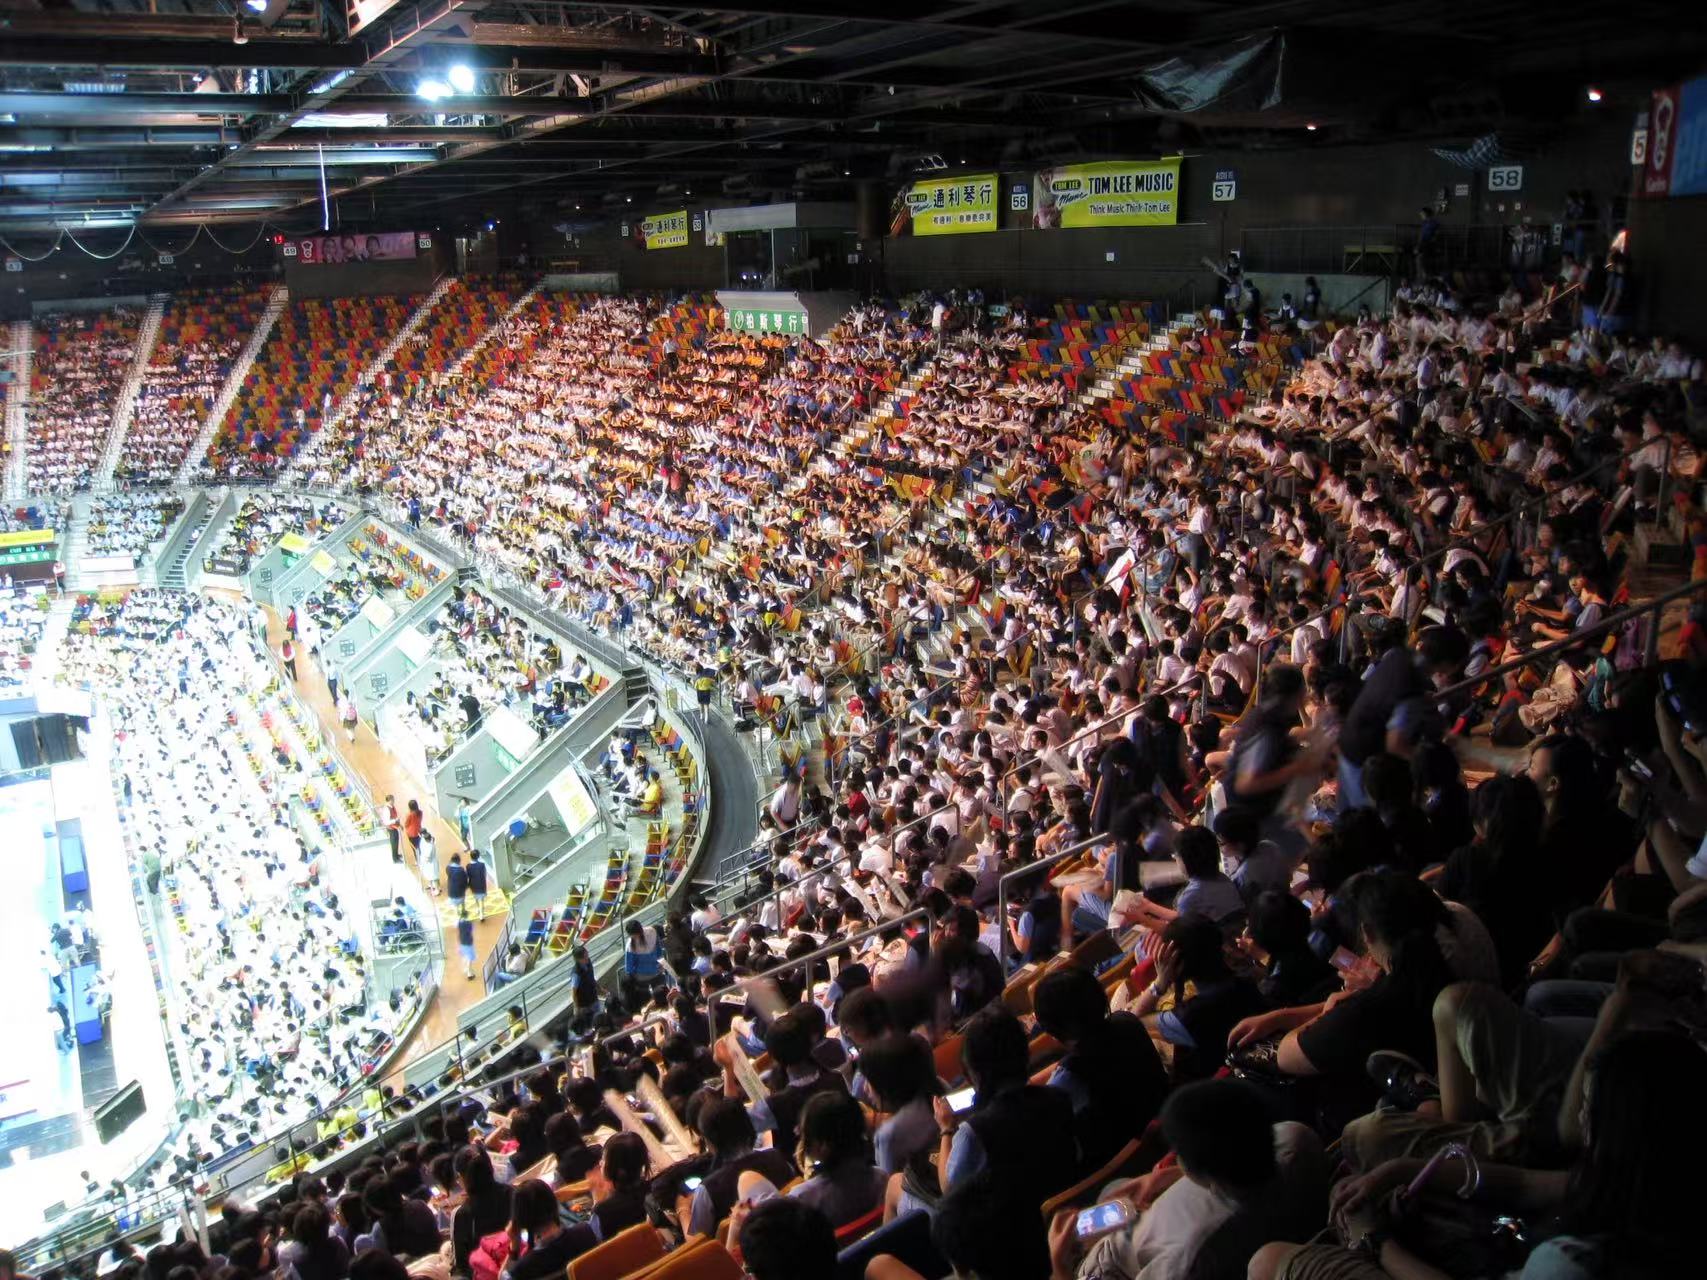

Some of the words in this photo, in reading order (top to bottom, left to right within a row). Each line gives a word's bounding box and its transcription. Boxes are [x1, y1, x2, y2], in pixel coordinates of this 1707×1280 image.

[1054, 181, 1067, 190] TOM
[1068, 180, 1079, 189] LEE
[1088, 176, 1110, 195] TOM
[1113, 174, 1132, 193] LEE
[1135, 172, 1173, 193] MUSIC
[1492, 170, 1519, 187] 58
[933, 184, 992, 208] 通利琴行
[1215, 184, 1234, 198] 57
[1013, 196, 1027, 208] 56
[1089, 204, 1106, 215] Think
[1107, 204, 1125, 214] Music
[1126, 203, 1142, 213] Think
[1144, 203, 1158, 213] Tom
[1159, 203, 1170, 213] Lee
